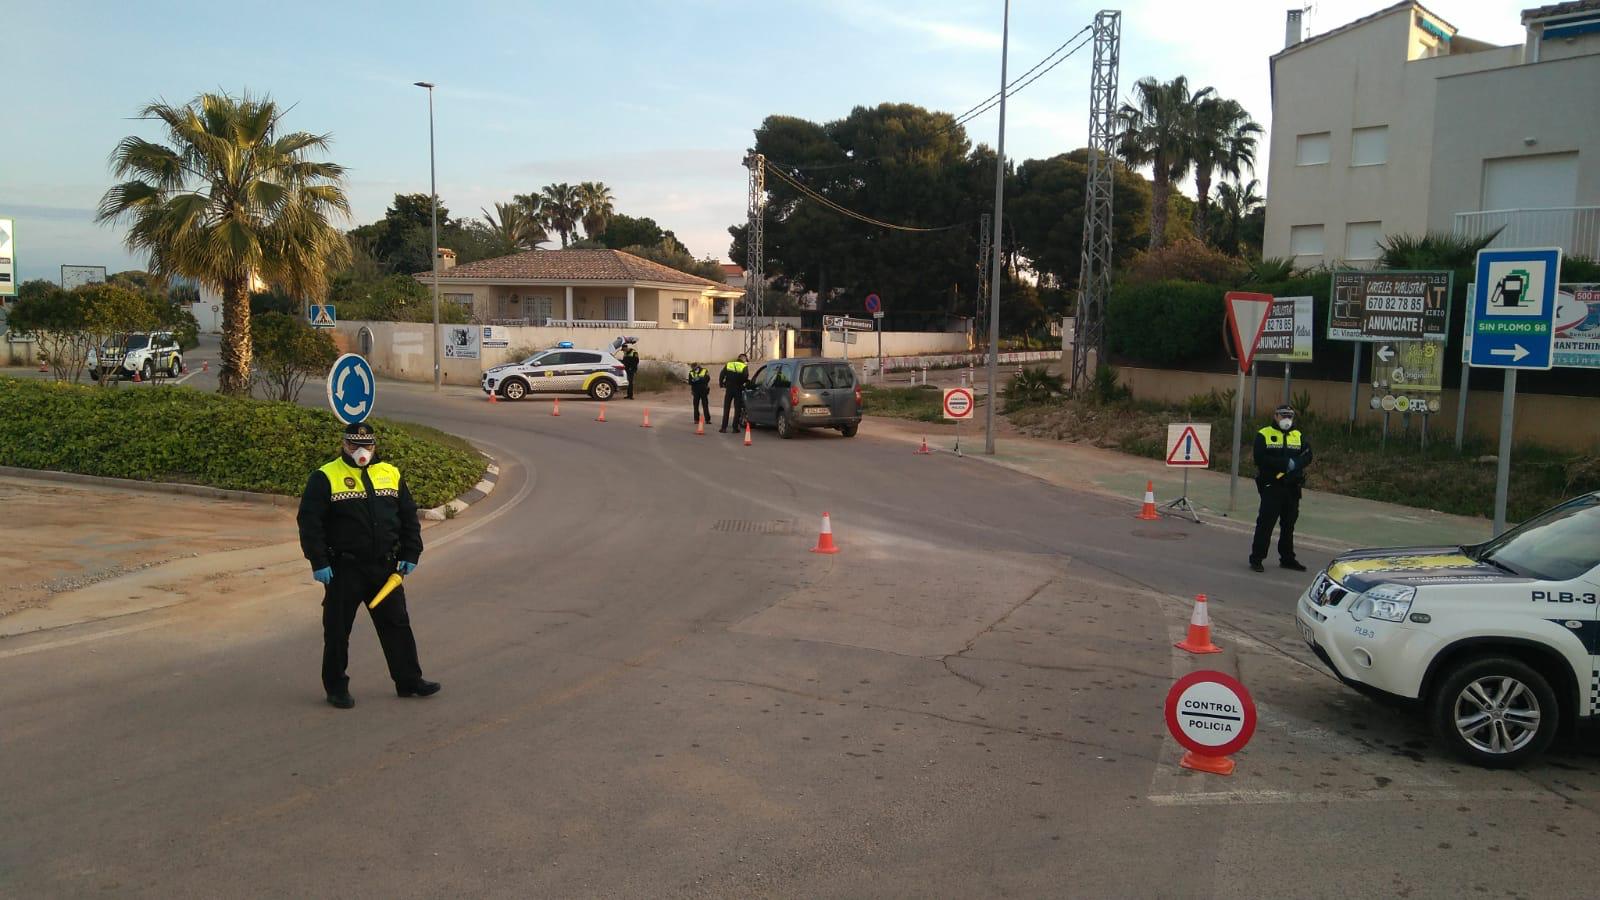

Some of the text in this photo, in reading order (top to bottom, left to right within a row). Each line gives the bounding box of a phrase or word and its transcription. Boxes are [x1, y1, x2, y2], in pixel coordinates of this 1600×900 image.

[1366, 281, 1427, 295] CARTELES PUBLISTRAT
[1576, 292, 1592, 300] 500
[1368, 298, 1421, 310] 670 82 78 85
[1479, 323, 1547, 332] SIN PLOMO 98
[1531, 591, 1596, 604] PLB-3
[1354, 626, 1375, 639] PLB-3
[1184, 700, 1238, 713] CONTROL
[1189, 719, 1232, 732] POLICIA
